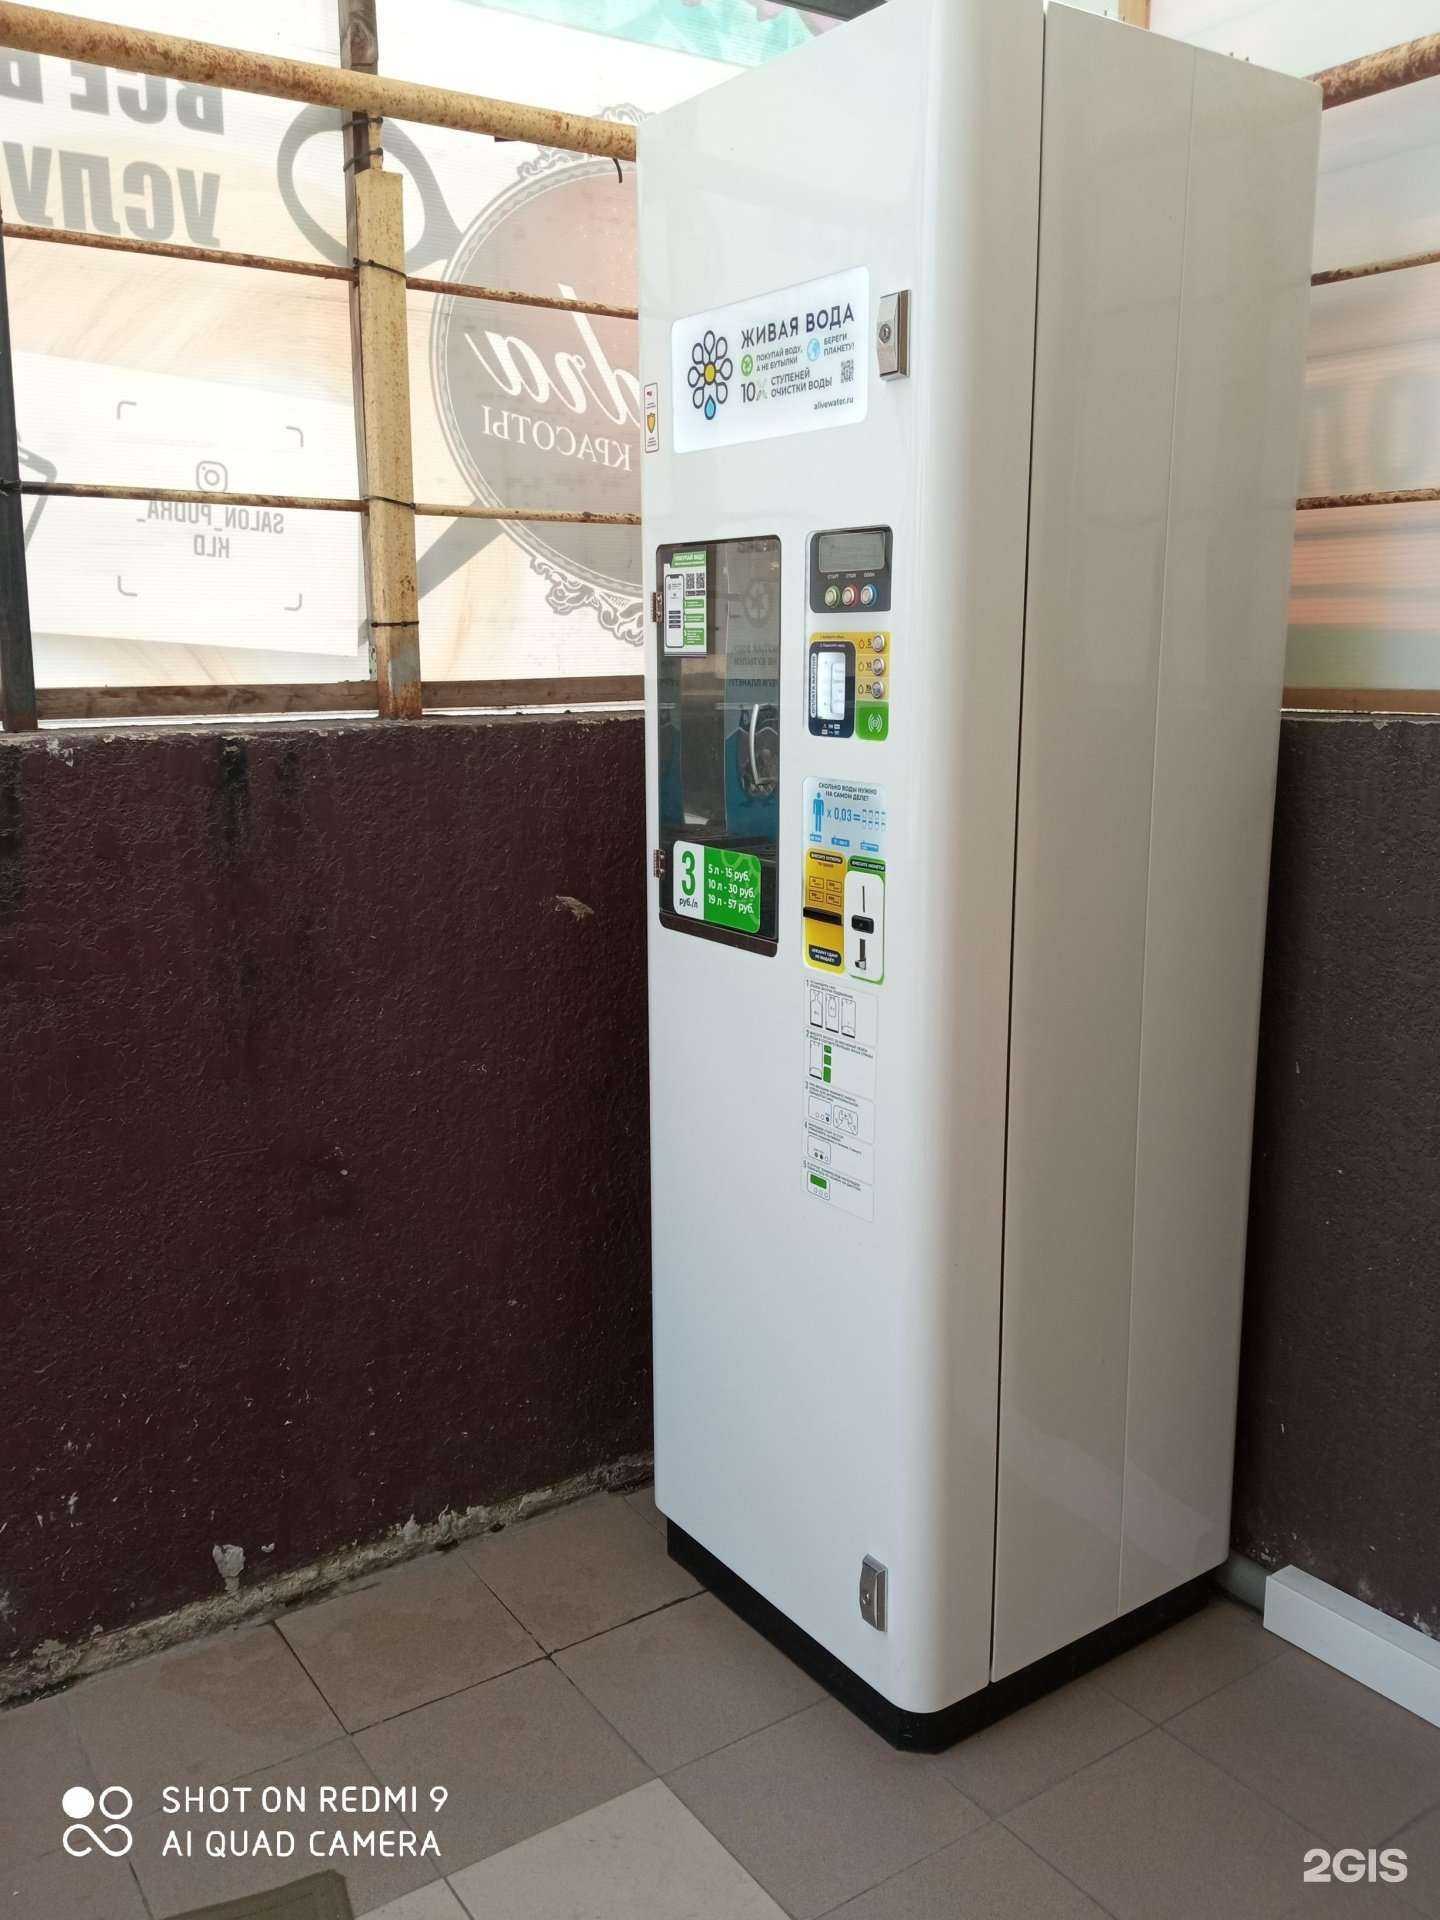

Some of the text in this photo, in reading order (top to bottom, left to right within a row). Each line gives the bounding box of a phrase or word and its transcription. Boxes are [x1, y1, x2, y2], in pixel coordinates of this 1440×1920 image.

[741, 302, 855, 350] ЖИВАЯ ВОДА
[823, 333, 848, 346] БЕРЕГИ
[756, 347, 784, 361] ПОКУПАЙ
[761, 362, 769, 371] НЕ
[770, 356, 798, 369] БУТЫЛКИ
[771, 367, 810, 386] СТУПЕНЕЙ
[771, 377, 833, 398] ОЧИСТКИ ВОДЫ
[813, 397, 854, 410] alivewater.ru
[819, 782, 841, 790] СКОЛЬКО
[841, 785, 857, 793] ВОДЫ
[681, 850, 696, 896] 3
[707, 863, 713, 874] 5
[713, 866, 719, 875] л
[725, 867, 733, 878] 15
[734, 870, 750, 882] руб.
[708, 878, 716, 890] 10
[717, 883, 723, 891] л
[728, 884, 738, 894] 30
[739, 887, 755, 899] руб.
[679, 897, 699, 909] руб./л
[708, 894, 716, 905] 19
[716, 898, 722, 906] л
[727, 899, 737, 910] 57
[738, 903, 754, 914] руб.
